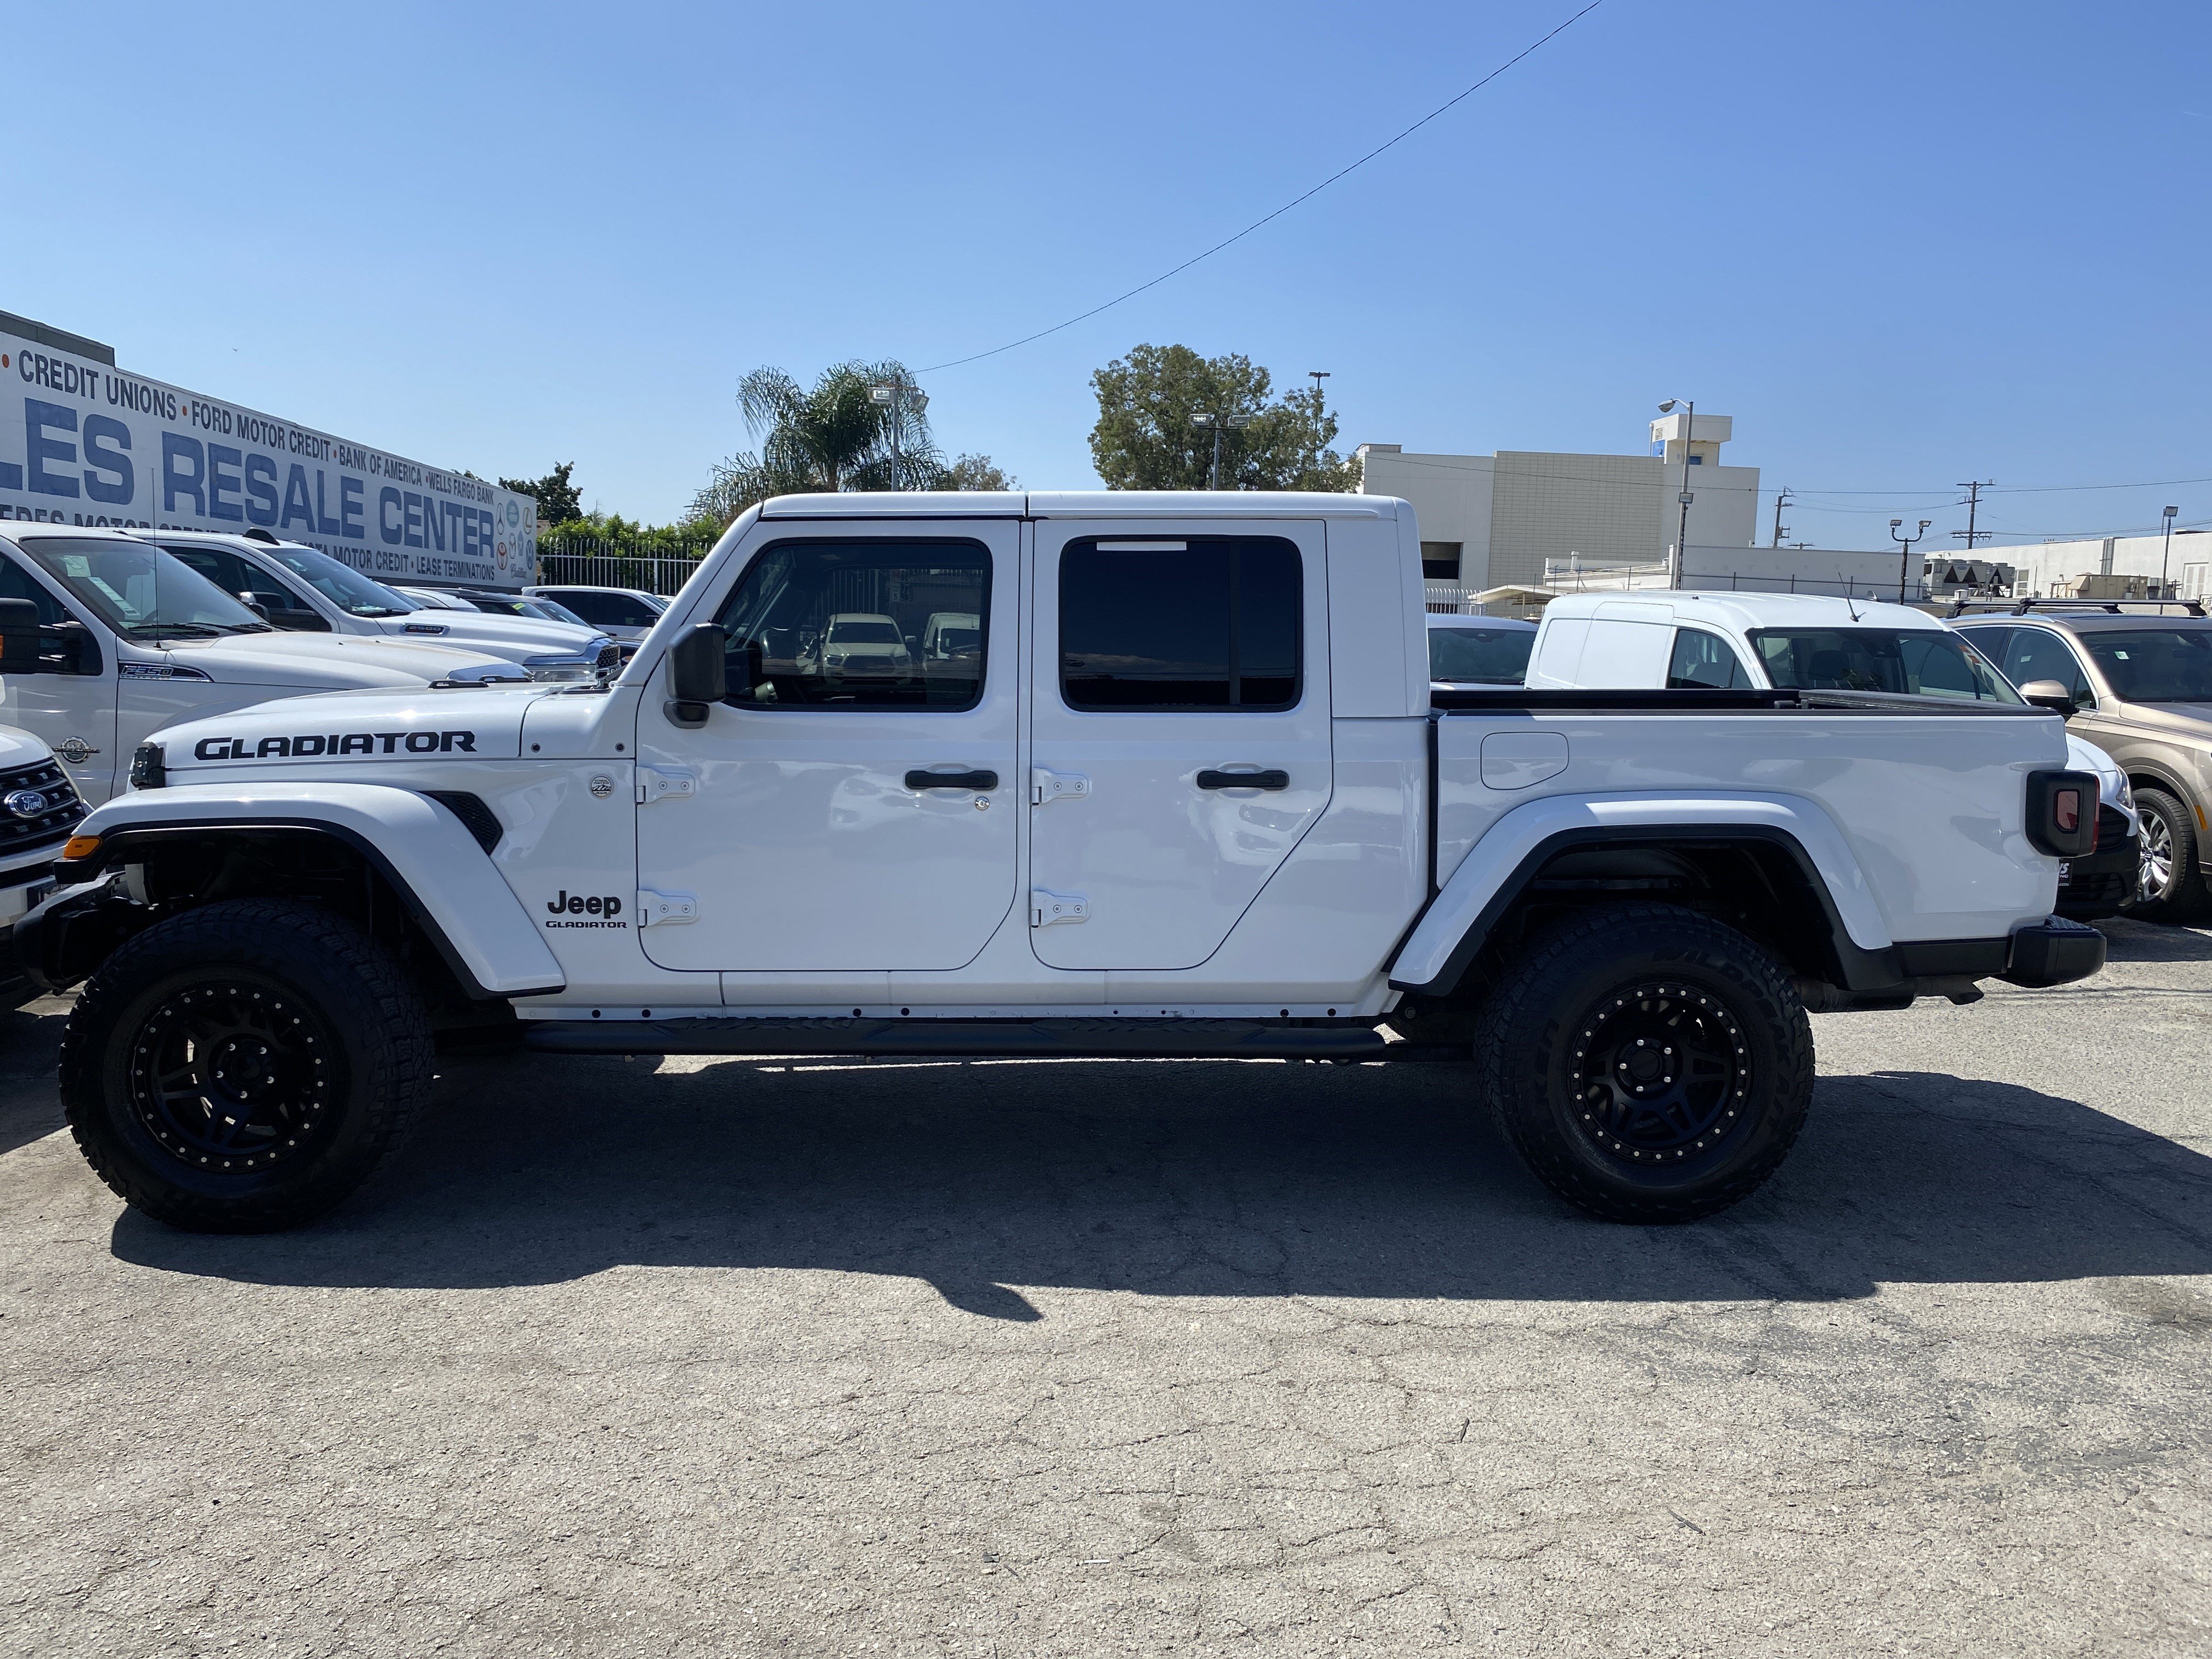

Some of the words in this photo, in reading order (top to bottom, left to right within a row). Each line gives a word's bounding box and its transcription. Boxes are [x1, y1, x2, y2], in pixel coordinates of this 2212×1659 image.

[19, 349, 99, 399] CREDIT
[106, 375, 177, 420] UNIONS
[192, 400, 232, 434] FORD
[237, 414, 285, 450] MOTOR
[290, 430, 330, 461] CREDIT
[340, 445, 366, 471] BANK
[370, 454, 381, 475] OF
[384, 459, 422, 486] AMERICA
[429, 471, 452, 494] WELLS
[454, 479, 475, 500] FARGO
[477, 486, 494, 505] BANK
[162, 431, 364, 539] RESALE
[380, 487, 494, 558] CENTER
[334, 545, 373, 569] MOTOR
[376, 551, 409, 572] CREDIT
[417, 556, 442, 575] LEASE
[443, 560, 495, 581] TERMINATIONS
[194, 731, 477, 760] GLADIATOR
[22, 795, 43, 811] Ford
[548, 890, 621, 919] Jeep
